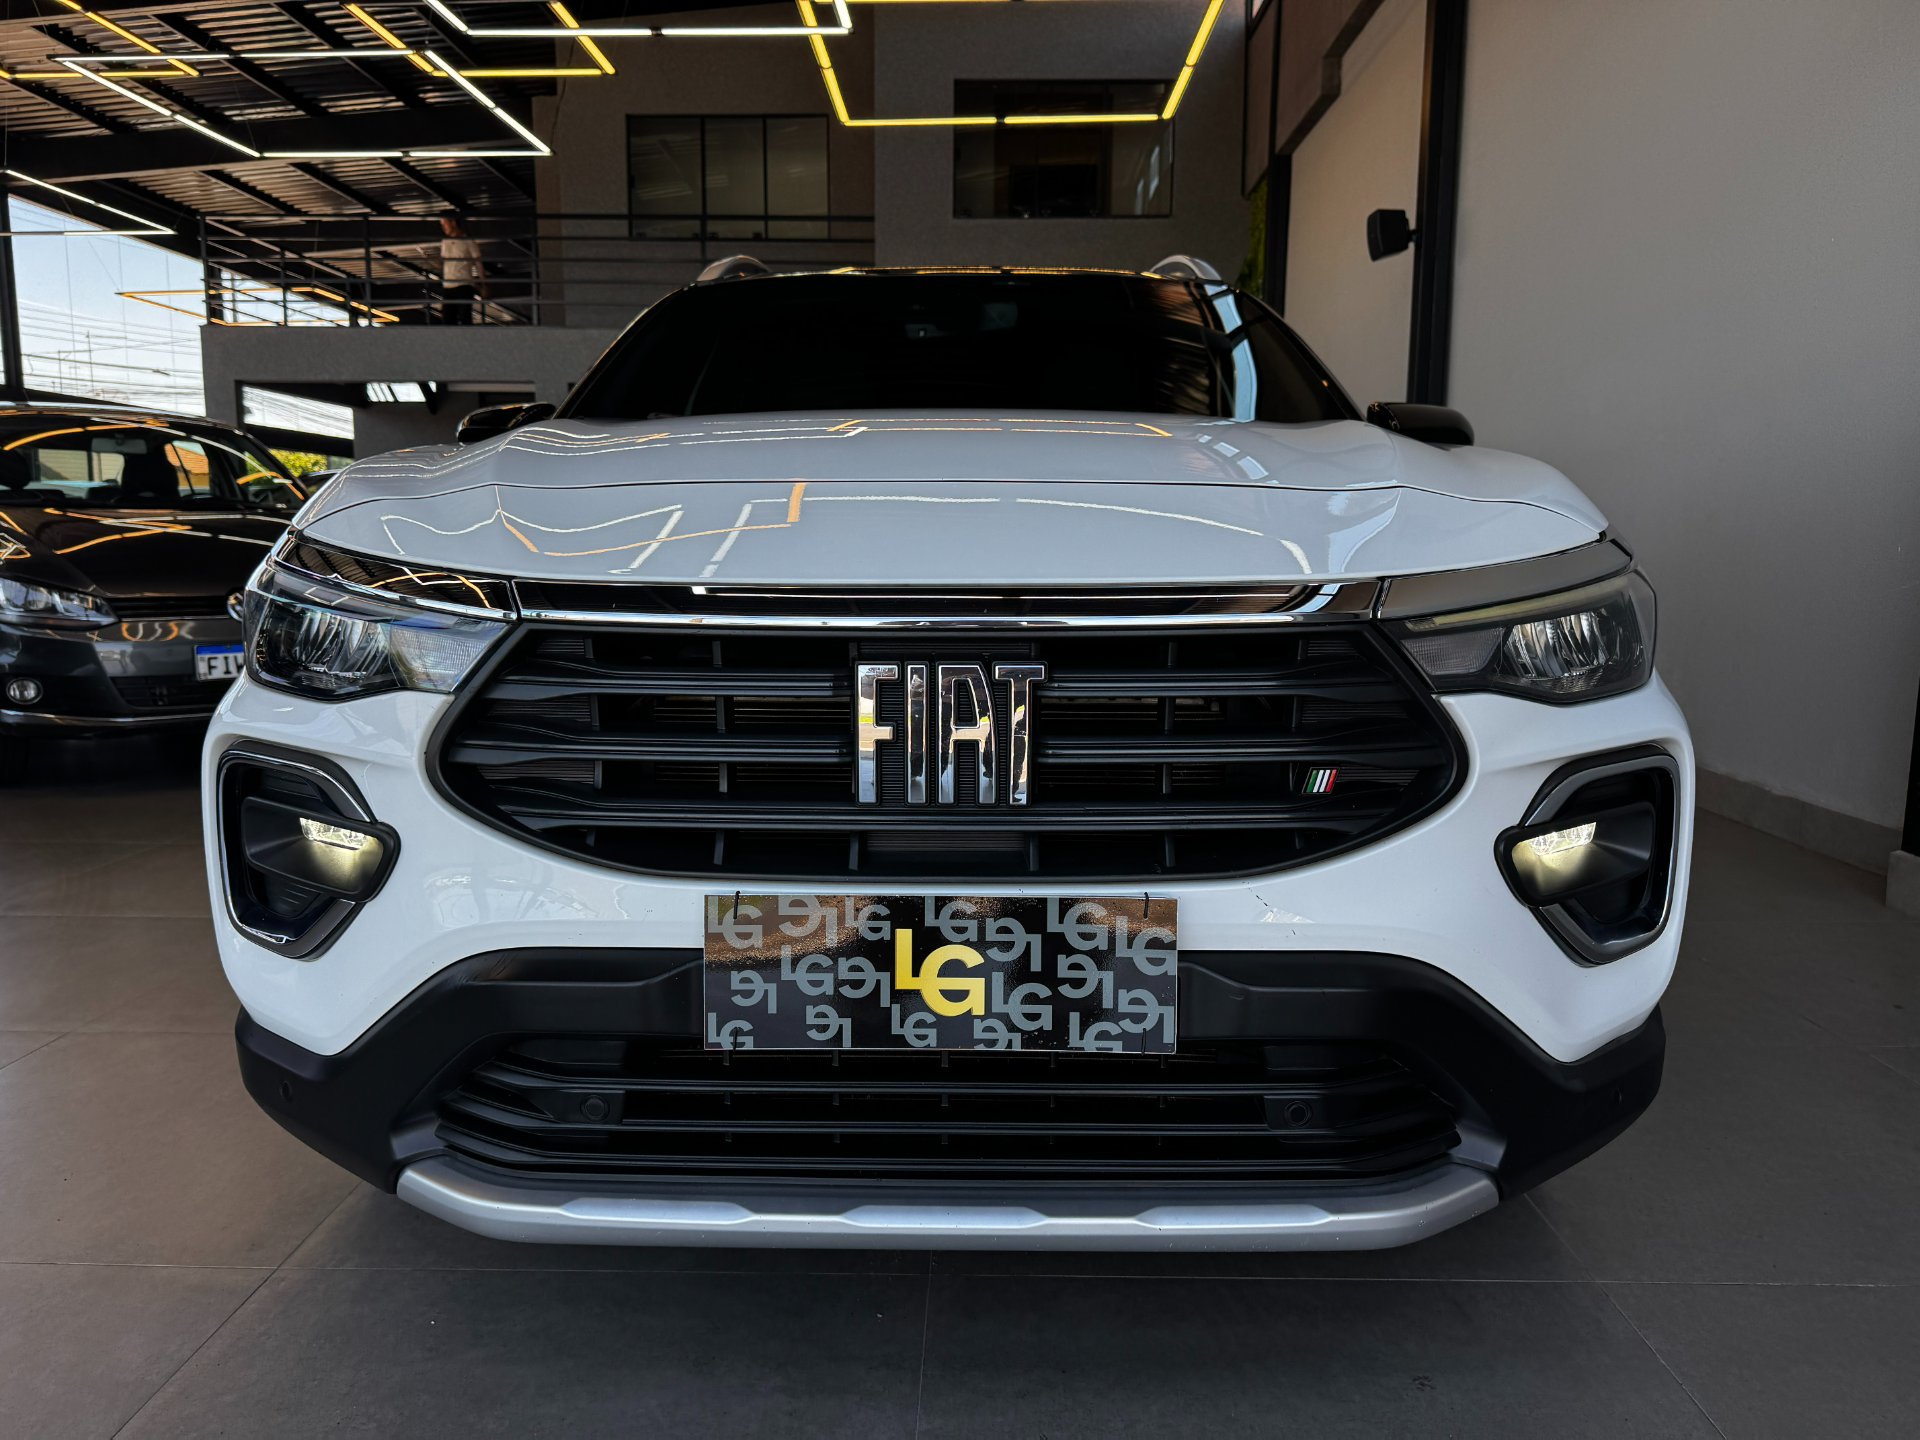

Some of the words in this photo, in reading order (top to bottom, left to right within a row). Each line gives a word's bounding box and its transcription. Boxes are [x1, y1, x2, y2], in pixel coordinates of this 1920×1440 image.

[858, 664, 1045, 805] FIAT
[708, 896, 763, 949] LG
[845, 896, 891, 941] LG
[925, 896, 978, 943] LG
[1047, 897, 1108, 951] LG
[781, 945, 834, 996] LG
[1116, 916, 1177, 976] LG
[895, 929, 986, 1017] LG
[891, 1004, 937, 1048] LG
[991, 971, 1053, 1031] LG
